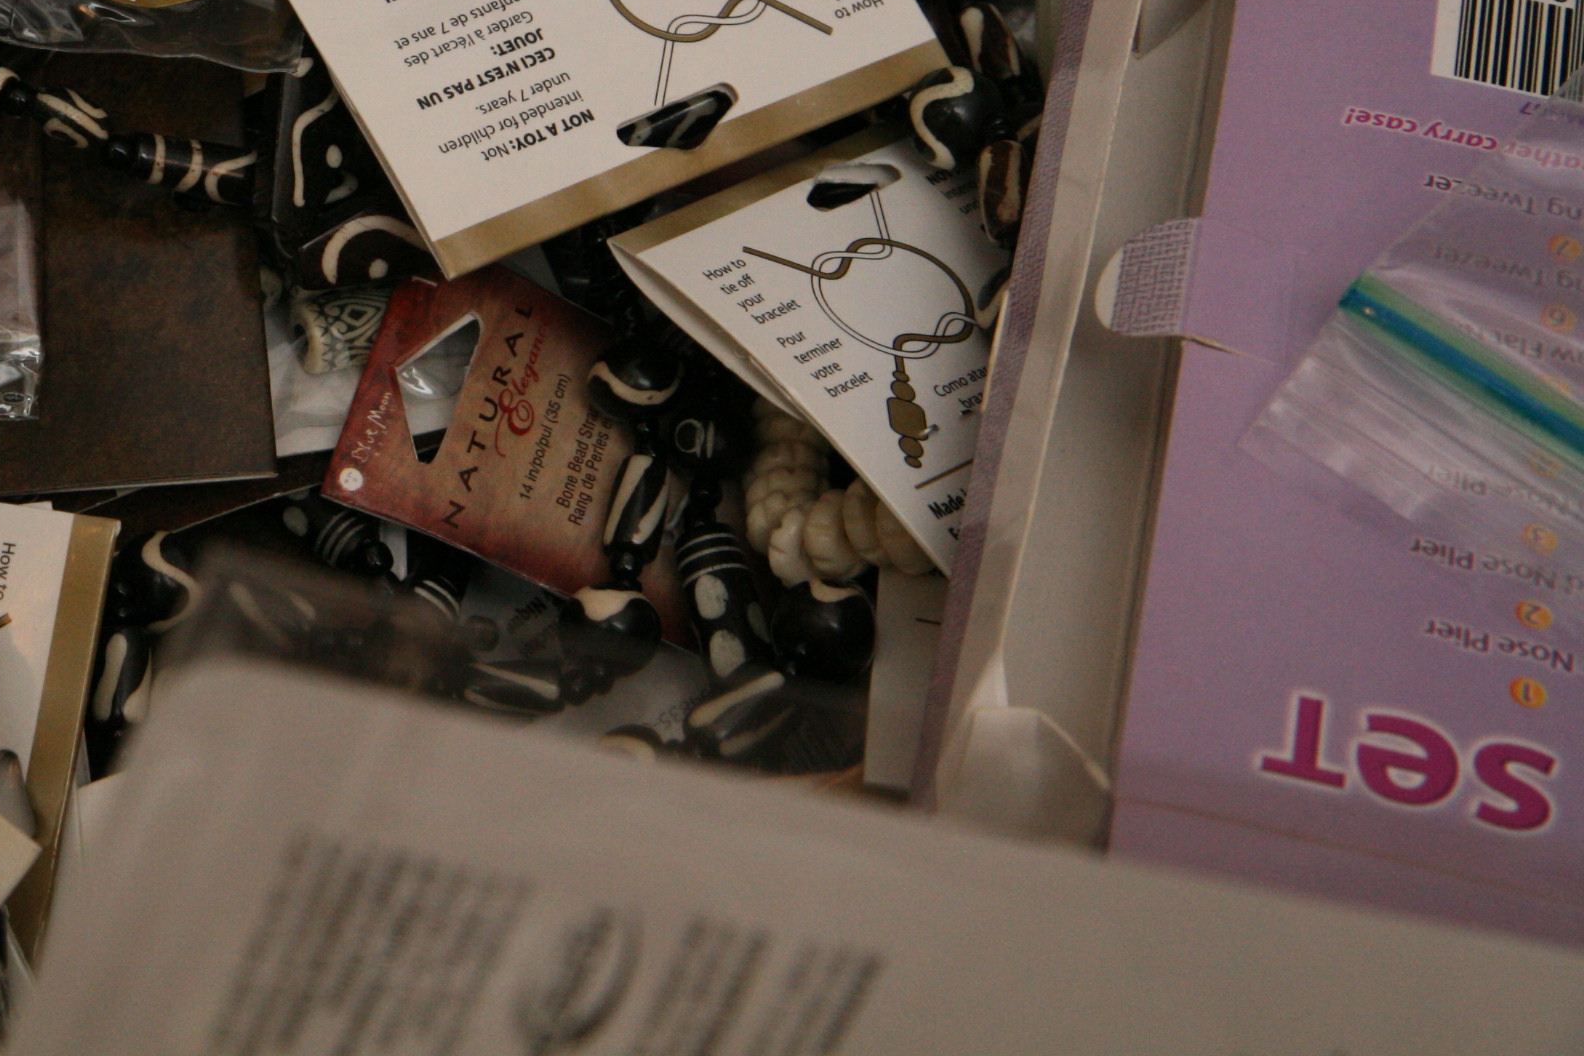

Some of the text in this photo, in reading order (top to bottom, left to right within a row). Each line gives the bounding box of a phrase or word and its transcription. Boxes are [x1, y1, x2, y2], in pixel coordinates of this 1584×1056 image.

[448, 11, 469, 31] de
[833, 5, 850, 20] to
[402, 8, 534, 71] Garder des
[415, 45, 556, 111] CECI PAS UN
[528, 70, 572, 97] under
[436, 89, 583, 157] intended for children
[479, 107, 594, 164] NOT A Not
[1343, 106, 1499, 152] carry case!
[702, 255, 747, 283] How to
[719, 272, 755, 297] tie off
[736, 291, 767, 314] your
[750, 296, 802, 326] bracelet
[776, 328, 806, 349] Pour
[792, 335, 844, 366] terminer
[809, 359, 843, 382] votre
[824, 369, 874, 399] bracelet
[549, 372, 572, 404] cm)
[932, 375, 967, 399] Como
[348, 386, 398, 464] Blue Moon
[440, 299, 535, 530] NATURAL
[542, 402, 562, 424] (35
[555, 438, 591, 508] Bone Bead
[567, 429, 611, 526] Rang de Perles
[517, 482, 533, 501] 14
[927, 487, 966, 522] Made
[1407, 537, 1558, 591] Nose Plier
[1422, 619, 1574, 672] Nose Plier
